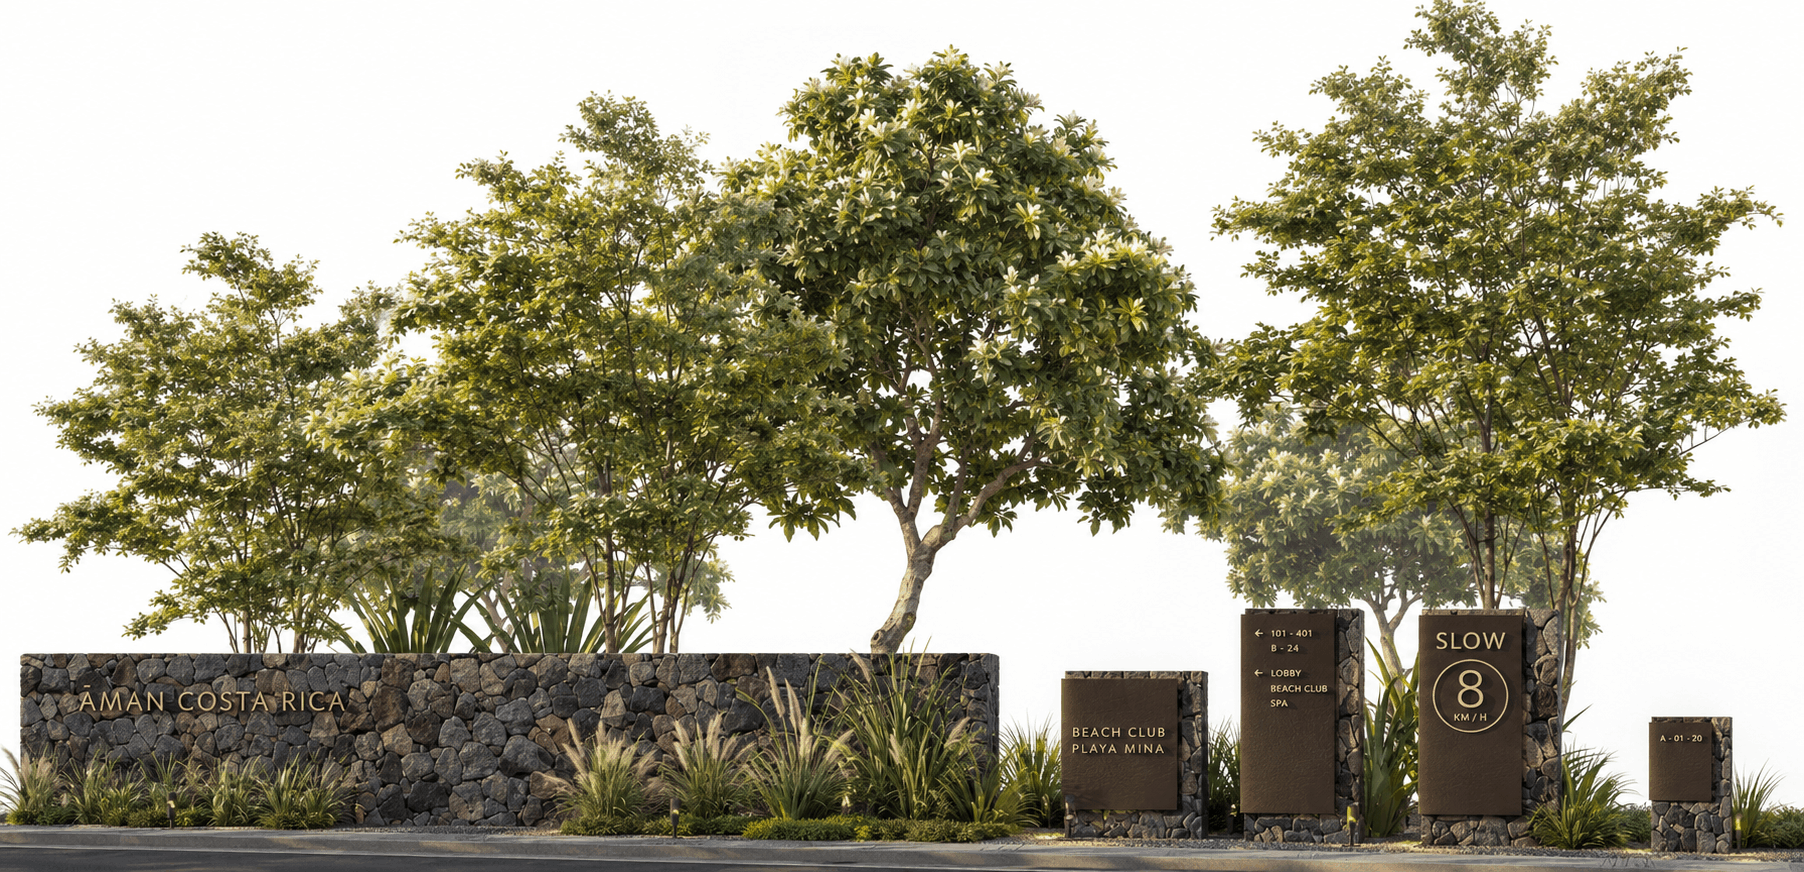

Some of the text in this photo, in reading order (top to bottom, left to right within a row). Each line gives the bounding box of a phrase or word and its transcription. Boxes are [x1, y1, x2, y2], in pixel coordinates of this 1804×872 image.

[1271, 629, 1286, 638] 101
[1295, 629, 1313, 638] 401
[1436, 631, 1506, 650] SLOW
[1271, 644, 1277, 653] B
[1287, 644, 1299, 653] 24
[1270, 669, 1302, 678] LOBBY
[1270, 684, 1328, 693] BEACH CLUB
[1457, 669, 1484, 709] 8
[178, 691, 269, 711] COSTA
[282, 691, 345, 711] RICA
[1270, 699, 1288, 708] SPA
[1072, 726, 1166, 738] BEACH CLUB
[1659, 734, 1667, 742] A
[1072, 743, 1165, 754] PLAYA MINA
